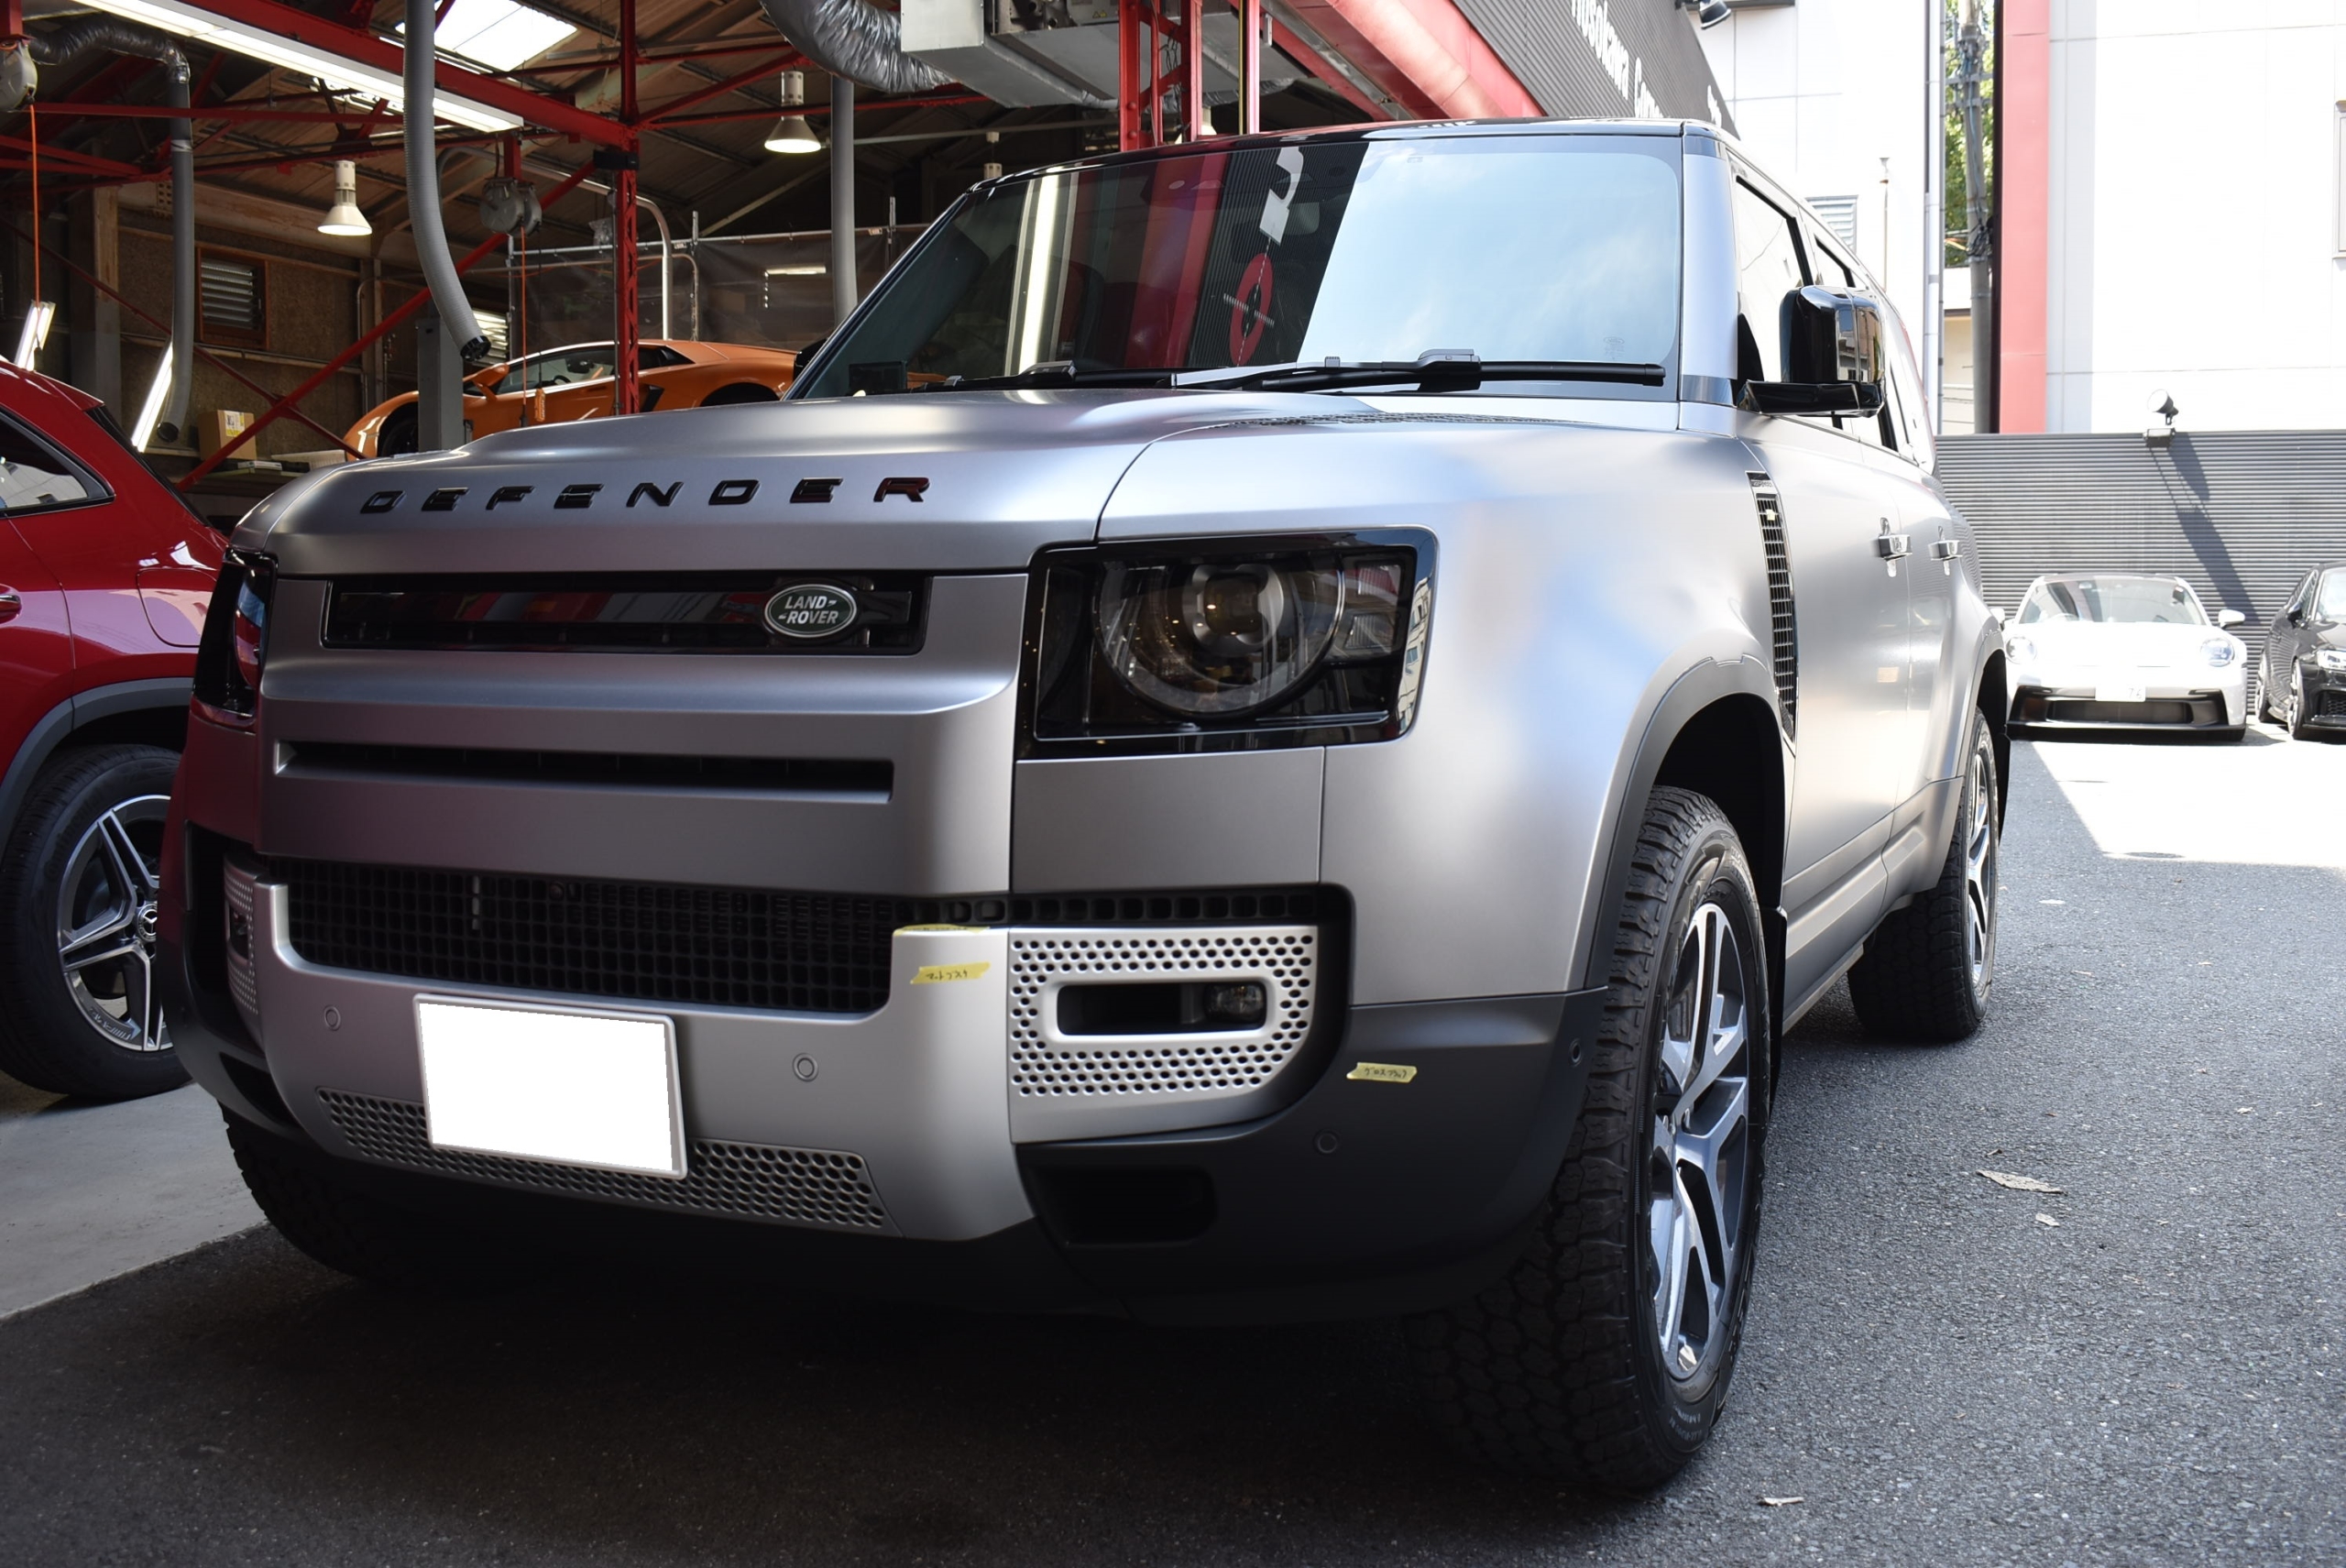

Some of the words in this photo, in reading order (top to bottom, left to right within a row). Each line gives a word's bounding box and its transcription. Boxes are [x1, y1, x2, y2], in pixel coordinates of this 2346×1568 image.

[359, 477, 930, 514] DEFENDER
[784, 596, 828, 609] LAND
[786, 610, 839, 624] ROVER
